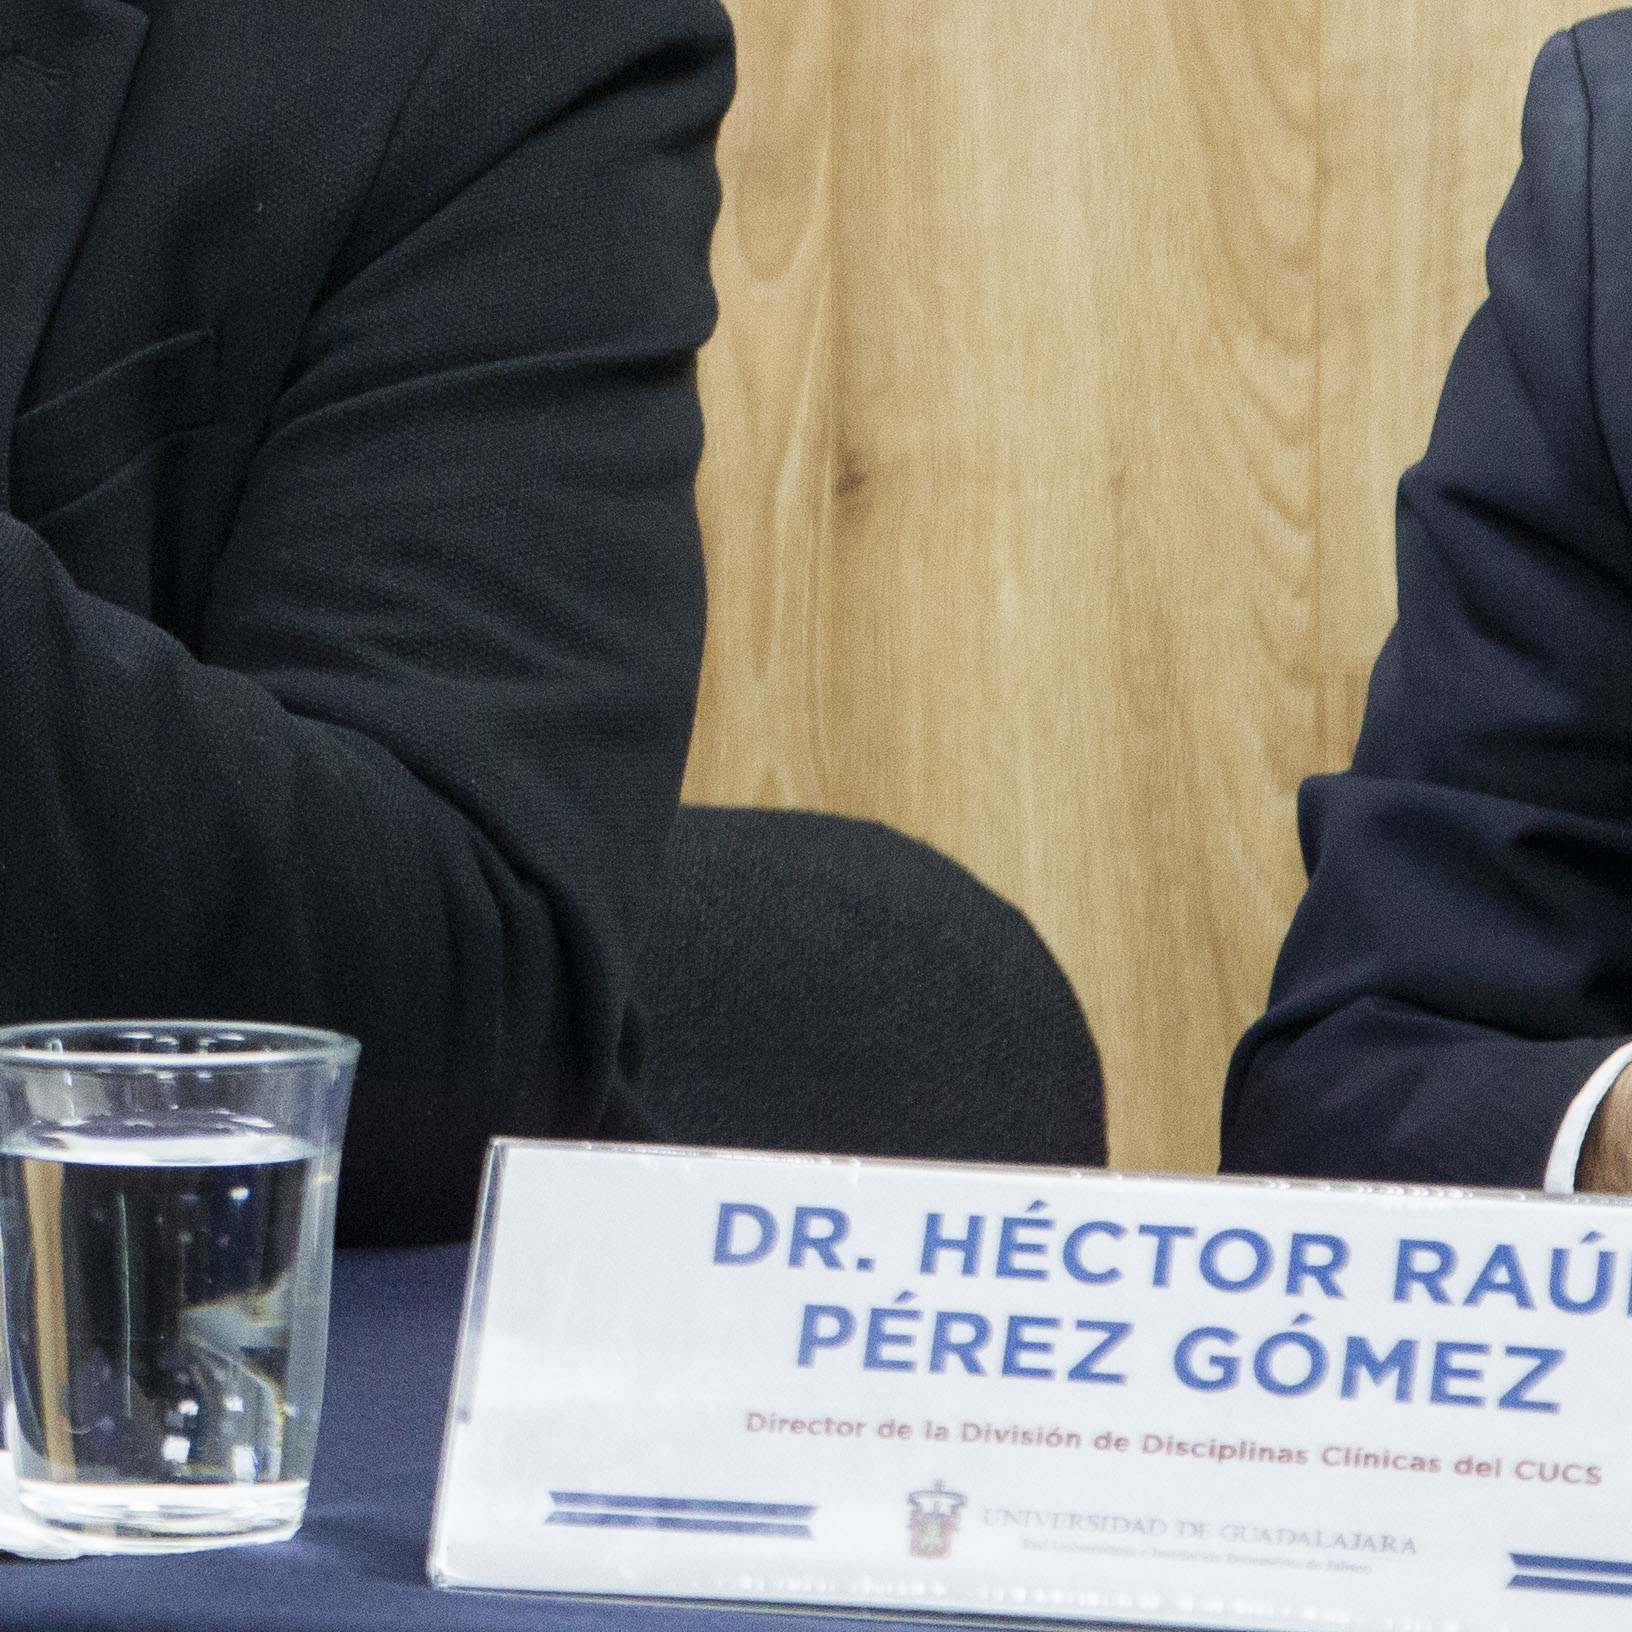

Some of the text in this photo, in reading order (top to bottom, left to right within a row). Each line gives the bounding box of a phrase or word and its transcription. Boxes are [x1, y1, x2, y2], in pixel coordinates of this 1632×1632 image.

[711, 1200, 1632, 1318] DR. HÉCTOR RAÚ
[796, 1290, 1566, 1415] PÉREZ GÓMEZ
[746, 1412, 1603, 1486] Director de la División de Disciplinas Clínicas del CUCS
[982, 1507, 1418, 1556] UNIVERSIDAD DE GUADALAJARA
